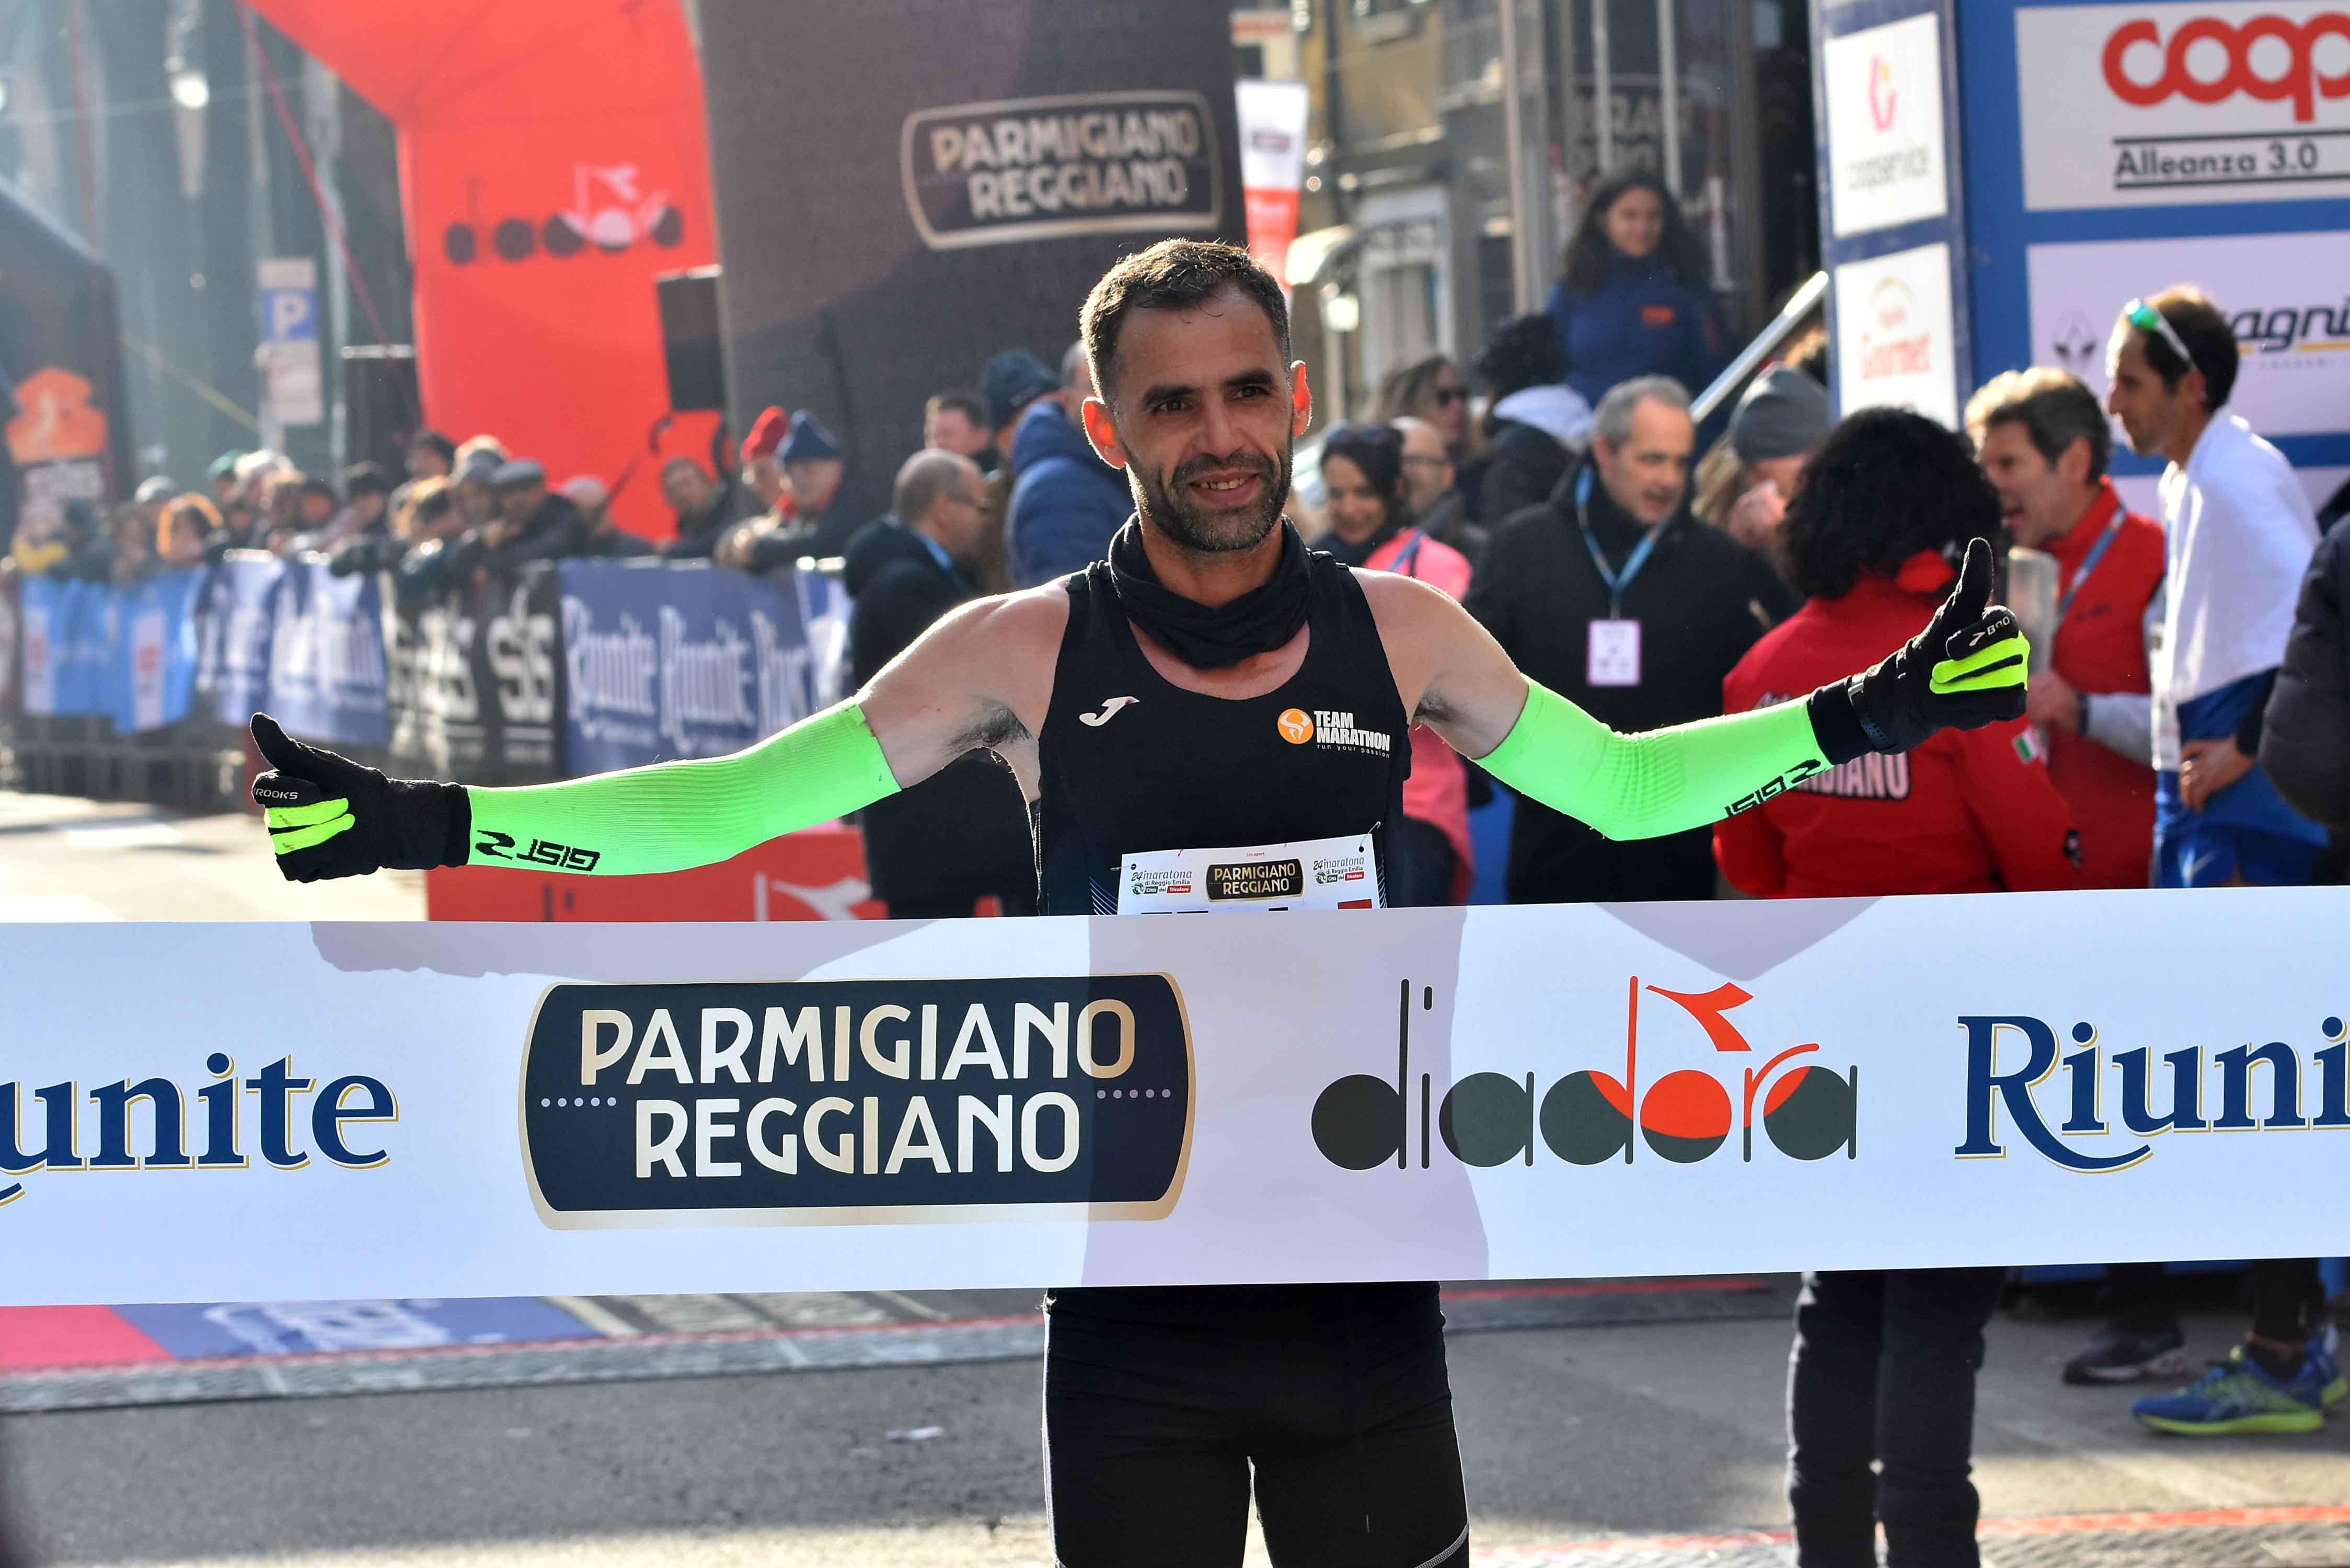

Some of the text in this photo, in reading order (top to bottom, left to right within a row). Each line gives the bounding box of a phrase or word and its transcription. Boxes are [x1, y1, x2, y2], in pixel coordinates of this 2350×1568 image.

[2102, 10, 2350, 123] coop
[930, 109, 1201, 172] PARMIGIANO
[2115, 140, 2319, 177] Alleanza 3.0
[967, 159, 1189, 218] REGGIANO
[2226, 294, 2350, 354] agni
[1314, 710, 1354, 729] TEAM
[1316, 727, 1390, 752] MARATHON
[1361, 747, 1390, 759] passion
[254, 788, 298, 799] ROOKS
[516, 838, 601, 872] GIST
[1214, 862, 1296, 881] PARMIGIANO
[1223, 878, 1290, 895] REGGIANO
[580, 998, 1136, 1086] PARMIGIANO
[1310, 975, 1858, 1171] diadora
[1954, 1015, 2350, 1174] Riuni
[635, 1091, 1080, 1179] REGGIANO
